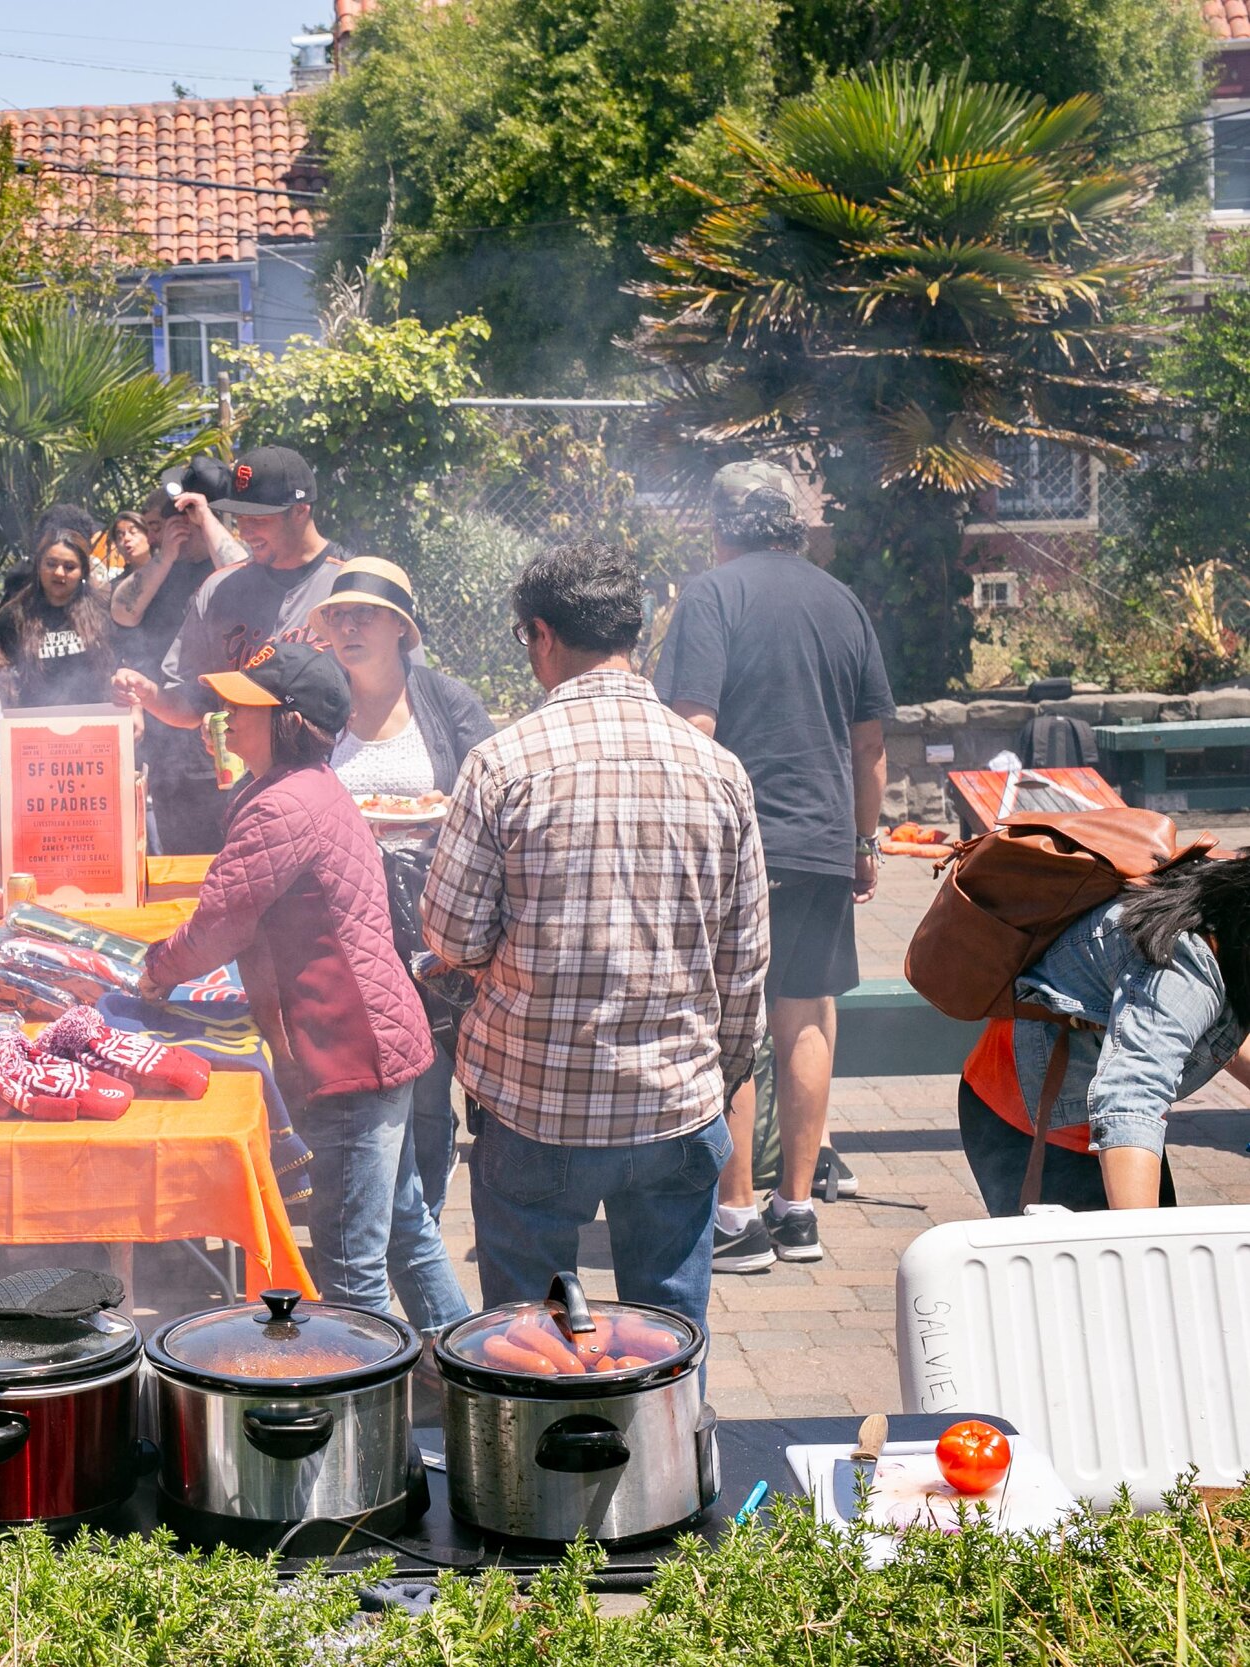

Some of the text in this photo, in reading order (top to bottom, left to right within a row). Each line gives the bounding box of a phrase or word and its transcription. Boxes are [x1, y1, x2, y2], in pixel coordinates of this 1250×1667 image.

[28, 761, 104, 777] SF GIANTS
[57, 780, 75, 794] VS
[26, 797, 107, 812] SD PADRES
